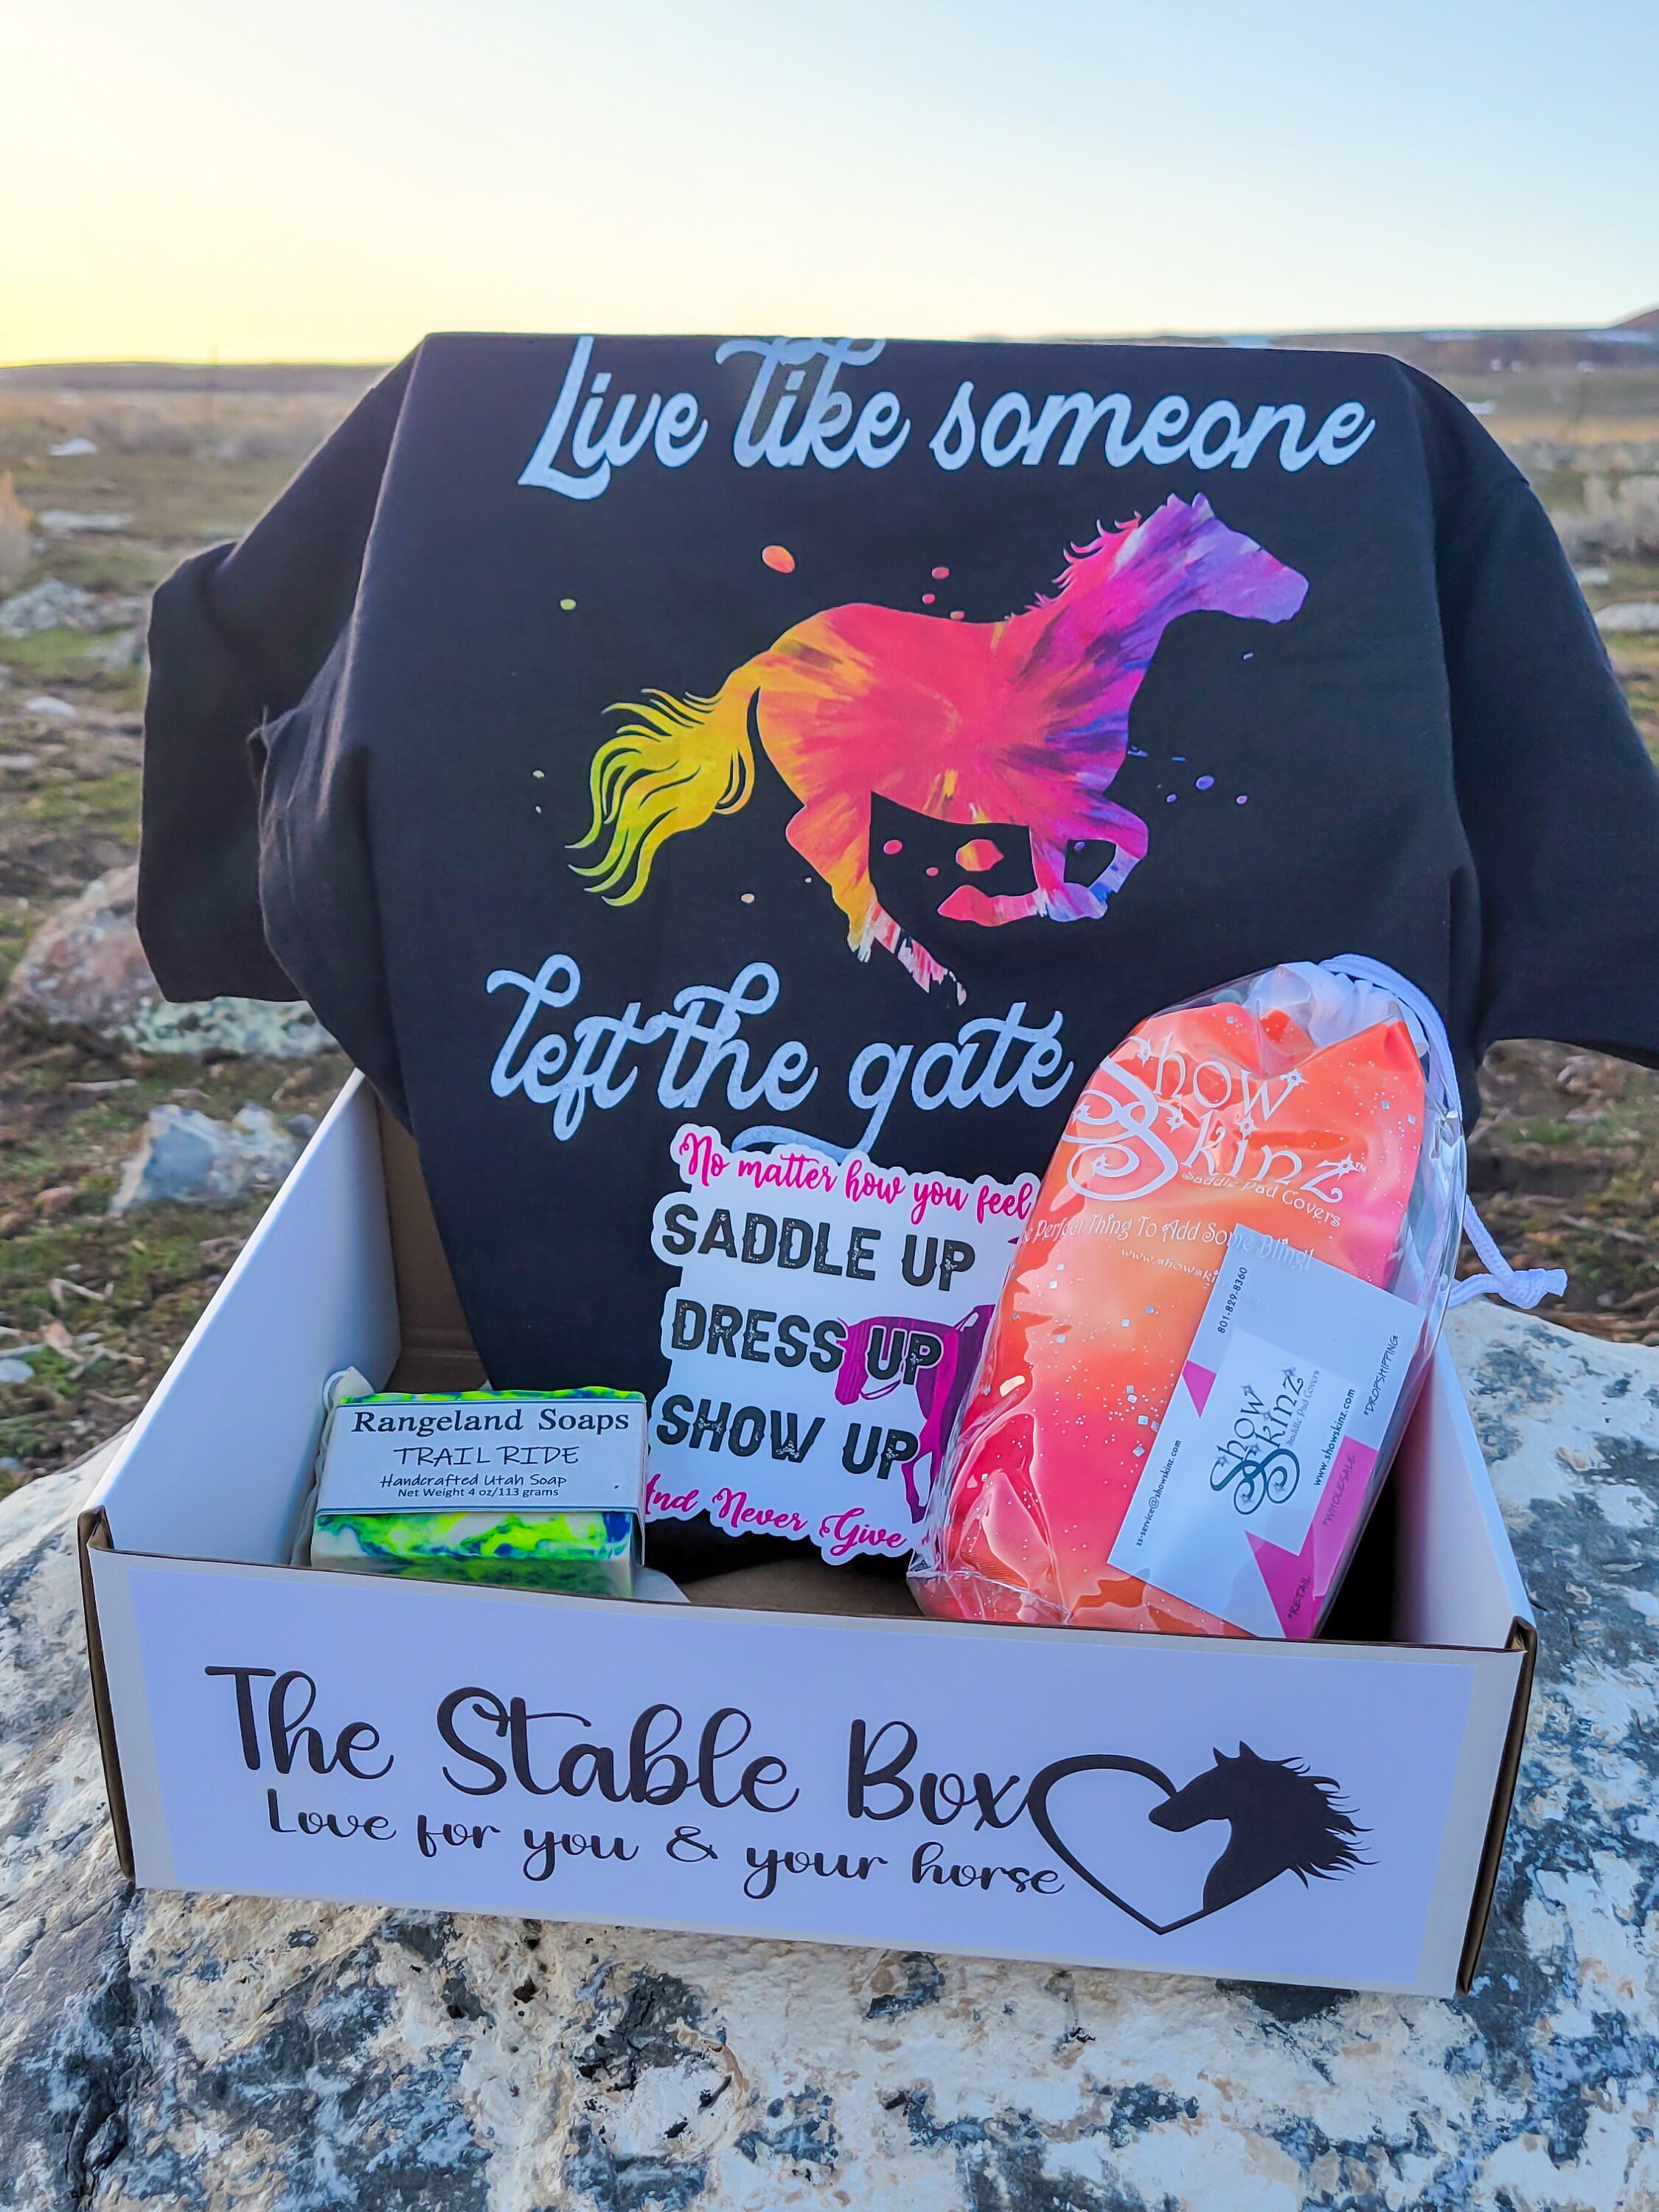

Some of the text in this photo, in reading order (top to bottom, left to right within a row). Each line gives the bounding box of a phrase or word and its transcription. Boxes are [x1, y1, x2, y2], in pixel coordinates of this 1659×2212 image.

[518, 336, 1376, 500] Live like someone
[487, 953, 1074, 1165] left the gate
[679, 1132, 1034, 1225] No matter how you feel
[1181, 1171, 1238, 1188] Saddle
[1281, 1189, 1340, 1227] Covers
[661, 1203, 976, 1292] SADDLE UP
[1088, 1213, 1133, 1241] Thing
[1138, 1215, 1158, 1238] To
[1161, 1219, 1200, 1243] Add
[1201, 1222, 1253, 1253] Some
[670, 1298, 942, 1385] DRESS UP
[1217, 1267, 1248, 1334] 801-829-8360
[351, 1408, 630, 1437] Rangeland Soaps
[393, 1445, 580, 1468] TRAIL RIDE
[655, 1394, 919, 1481] SHOW UP
[1210, 1384, 1267, 1515] Show
[1314, 1388, 1356, 1486] www.showskinz.com
[380, 1473, 568, 1489] Handcrafted Utah Soap
[398, 1487, 560, 1500] Net Weight 4 oz/113 grams
[712, 1486, 809, 1532] Never
[818, 1506, 908, 1557] Give
[1136, 1439, 1182, 1547] ss-service@showskinz.com
[205, 1664, 1030, 1834] The Stable Box
[267, 1788, 1065, 1900] Love for you & your horse
